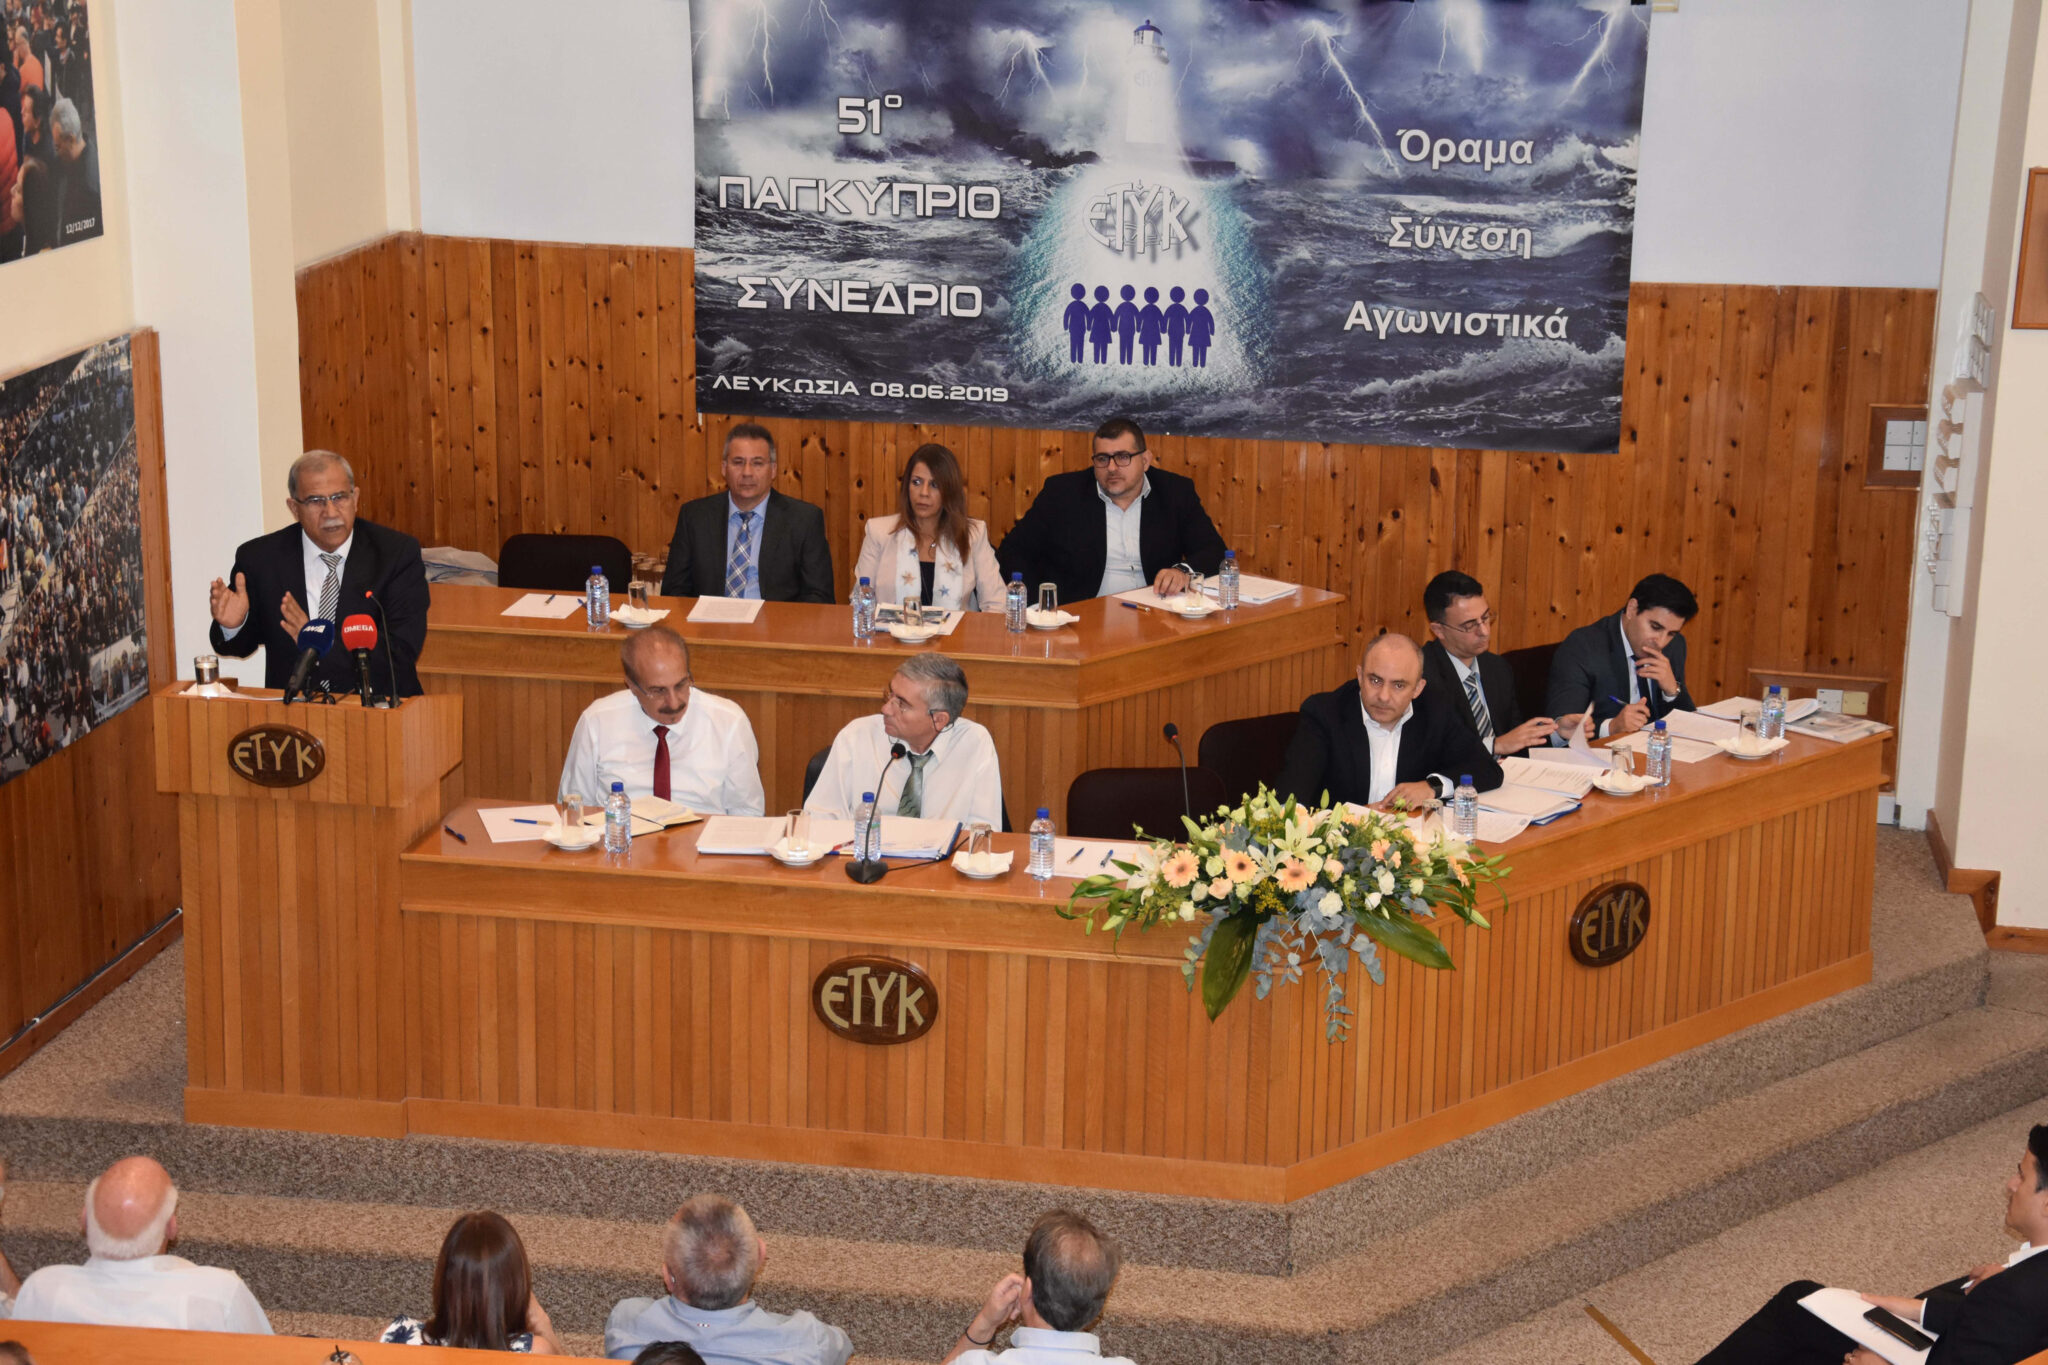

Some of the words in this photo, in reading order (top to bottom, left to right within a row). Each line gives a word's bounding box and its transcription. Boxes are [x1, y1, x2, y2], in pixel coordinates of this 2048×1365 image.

[1396, 129, 1534, 171] Όραμα
[719, 176, 1001, 219] ΠΑΓΚΥΠΡΙΟ
[1388, 216, 1532, 259] Σύνεση
[737, 276, 983, 318] ΣΥΝΕΔΡΙΟ
[1344, 300, 1569, 339] Αγωνιστικά
[712, 375, 860, 396] ΛΕΥΚΩΣΙΑ
[870, 382, 1009, 402] 08.06.2019
[343, 624, 374, 634] OMEGA
